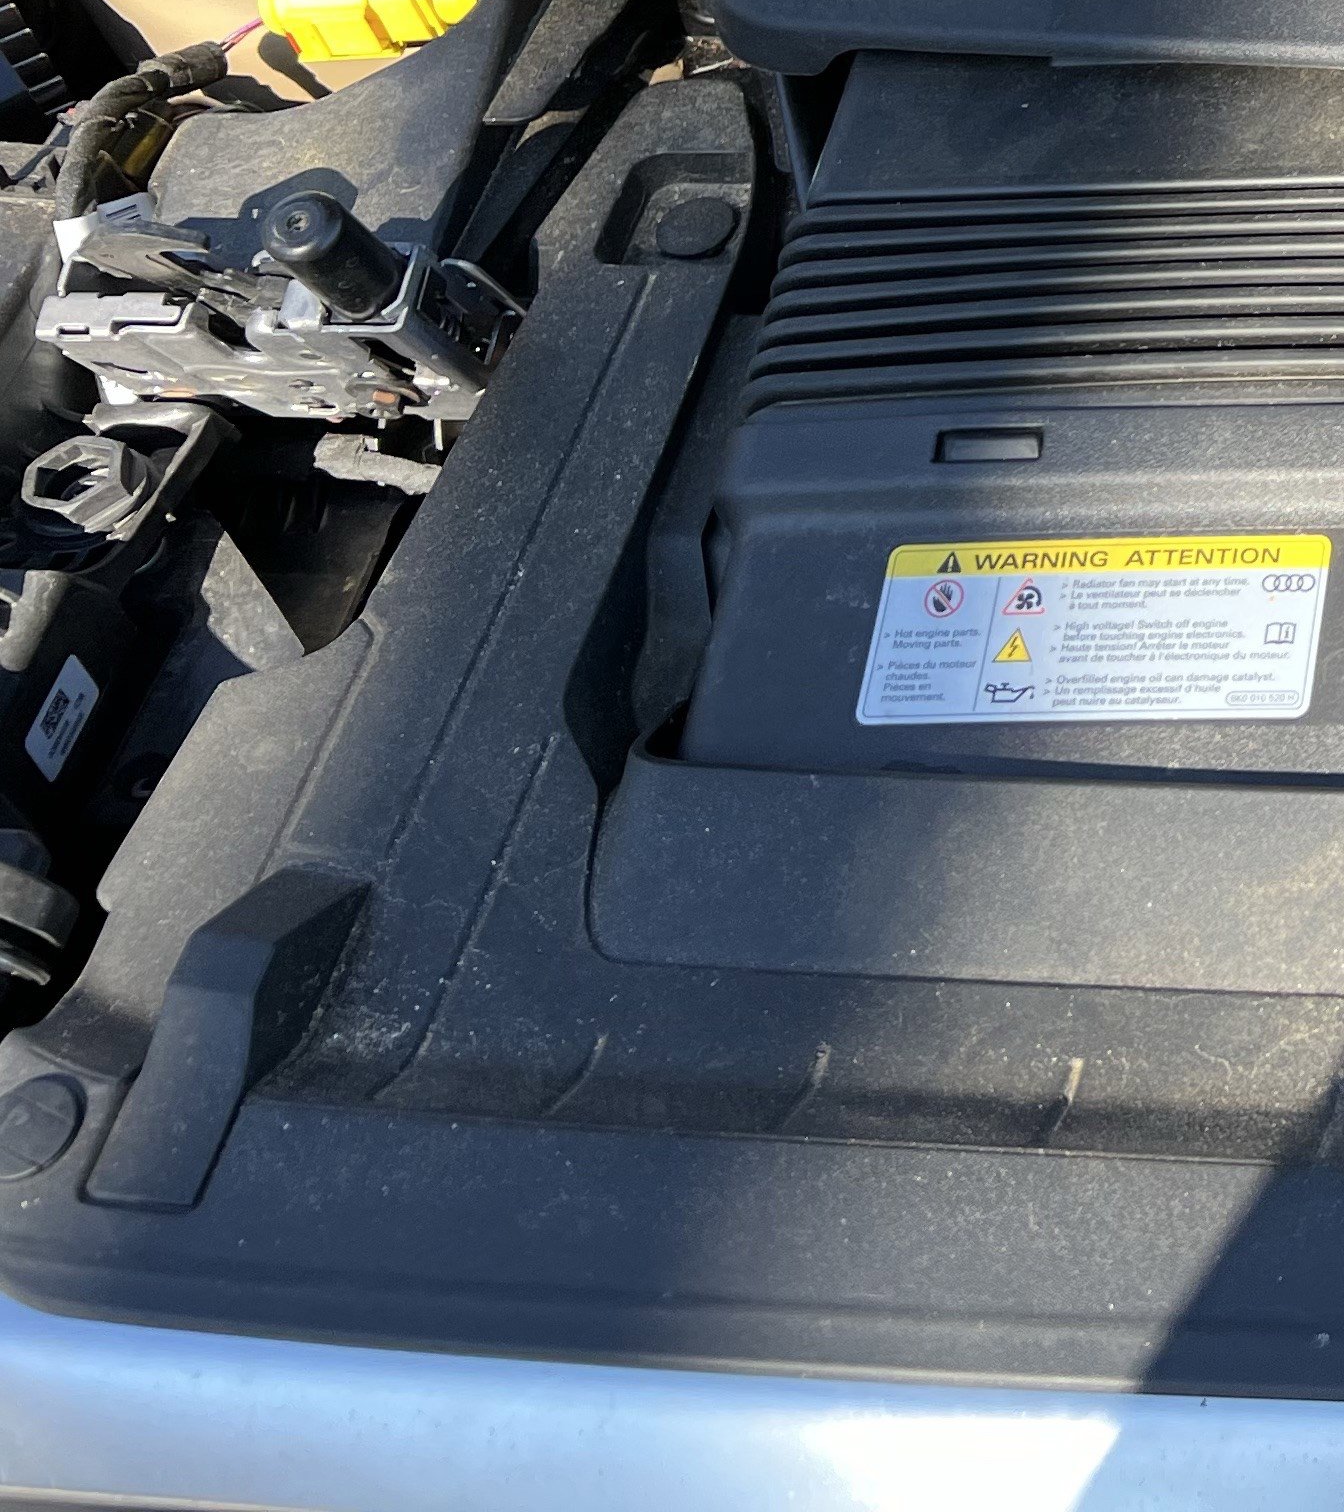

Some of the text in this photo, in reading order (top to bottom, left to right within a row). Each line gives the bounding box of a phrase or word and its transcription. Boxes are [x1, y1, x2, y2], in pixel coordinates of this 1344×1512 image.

[975, 548, 1281, 570] WARNING ATTENTION
[1073, 579, 1116, 589] Radiator
[1119, 579, 1136, 588] fan
[1137, 579, 1161, 589] may
[1163, 578, 1187, 587] start
[1189, 578, 1200, 586] at
[1202, 578, 1221, 587] any
[1071, 590, 1083, 599] Le
[1086, 589, 1140, 599] ventilateur
[1143, 590, 1167, 599] peut
[1078, 601, 1099, 609] tout
[1101, 600, 1148, 609] moment.
[1065, 619, 1228, 632] High voltage! Switch off engine
[895, 629, 980, 639] Hot engine parts.
[1100, 632, 1146, 641] touching
[1147, 631, 1184, 641] engine
[892, 640, 961, 649] Moving parts.
[1061, 643, 1092, 652] Haute
[1094, 642, 1137, 652] tension!
[1179, 641, 1188, 650] le
[1191, 641, 1230, 649] moteur
[1059, 654, 1088, 663] avant
[1090, 653, 1104, 662] de
[1106, 653, 1147, 662] toucher
[1233, 651, 1246, 660] du
[1249, 652, 1290, 660] moteur.
[922, 660, 936, 669] du
[939, 660, 977, 669] moteur
[886, 671, 930, 681] chaudes.
[1057, 674, 1108, 684] Overfilled
[1110, 674, 1146, 685] engine
[1149, 673, 1162, 683] oil
[1165, 674, 1183, 682] can
[1187, 672, 1229, 683] damage
[1055, 684, 1221, 696] Un remplissage excessif d'huile
[881, 693, 945, 702] mouvement.
[1052, 698, 1076, 707] peut
[1079, 697, 1106, 705] nuire
[1108, 697, 1122, 705] au
